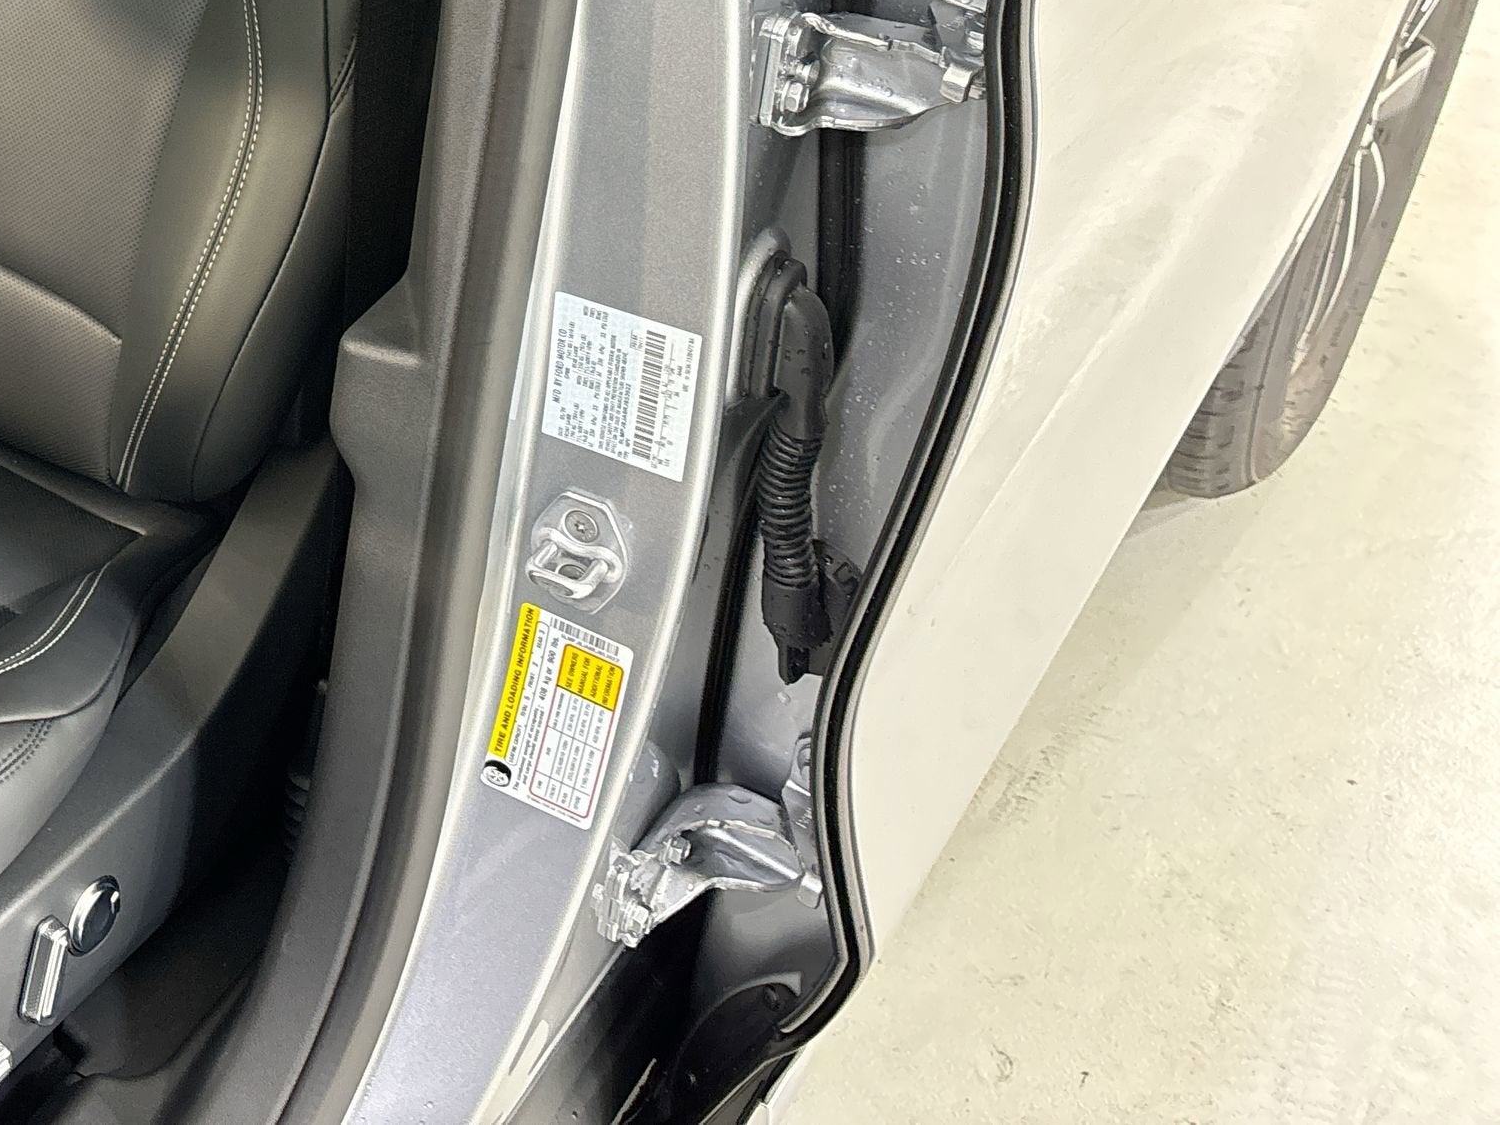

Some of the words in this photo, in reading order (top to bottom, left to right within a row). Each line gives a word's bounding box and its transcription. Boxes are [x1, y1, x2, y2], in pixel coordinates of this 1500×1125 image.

[555, 337, 566, 361] MOTOR
[554, 359, 564, 378] FORD
[553, 377, 562, 387] BY
[515, 606, 534, 668] INFORMATION
[545, 666, 552, 675] or
[581, 656, 590, 670] FOR
[505, 668, 522, 709] LOADING
[541, 674, 552, 686] kg
[565, 676, 573, 689] SEE
[576, 668, 588, 695] MANUAL
[588, 663, 603, 698] ADDITIONAL
[601, 665, 616, 706] INFORMATION
[499, 709, 511, 730] AND
[494, 730, 506, 754] TIRE
